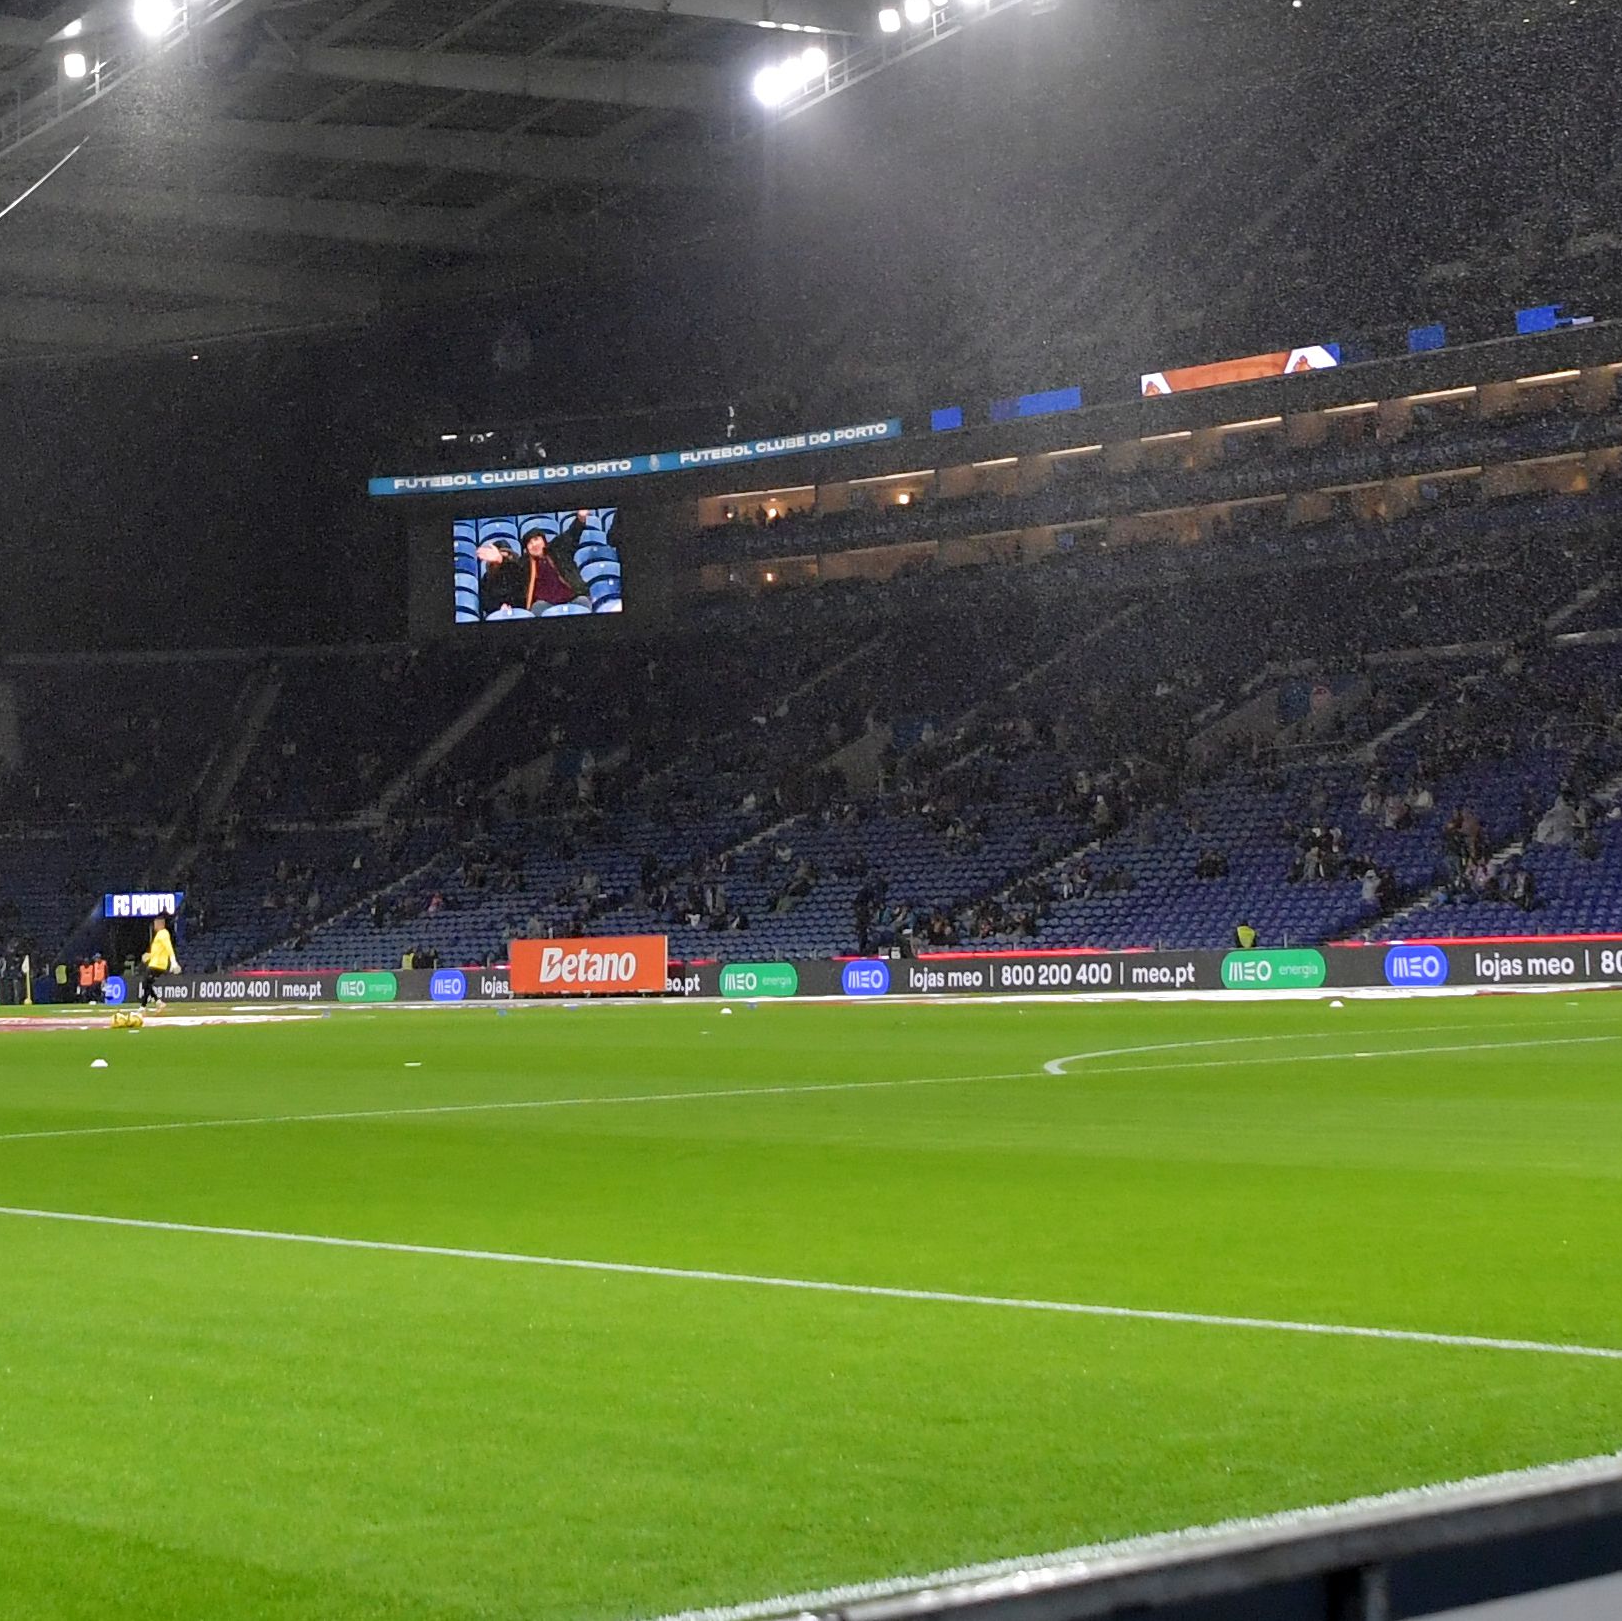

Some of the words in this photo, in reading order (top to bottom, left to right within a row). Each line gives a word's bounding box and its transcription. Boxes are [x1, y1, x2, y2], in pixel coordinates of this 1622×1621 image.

[679, 444, 752, 464] FUTEBOL
[755, 436, 806, 453] CLUBE
[809, 431, 831, 445] DO
[834, 423, 887, 441] PORTO
[394, 474, 477, 489] FUTEBOL
[481, 468, 540, 484] CLUBE
[543, 466, 569, 479] DO
[572, 460, 632, 476] PORTO
[113, 895, 130, 916] FC
[132, 894, 175, 915] PORTO
[539, 947, 637, 983] Betano
[1229, 960, 1271, 981] MEO
[1279, 962, 1318, 978] energia
[1393, 955, 1440, 978] MEO
[1475, 952, 1522, 981] lojas
[1527, 956, 1575, 976] meo
[434, 979, 461, 995] MEO
[481, 977, 509, 998] lojas
[665, 974, 700, 995] eo.pt
[725, 973, 757, 990] MEO
[848, 970, 883, 989] MEO
[910, 968, 945, 991] lojas
[948, 970, 983, 987] meo
[1001, 964, 1034, 985] 800
[1038, 964, 1072, 984] 200
[1076, 963, 1112, 984] 400
[1132, 963, 1195, 987] meo.pt
[165, 986, 188, 998] meo
[200, 982, 222, 998] 800
[224, 981, 246, 997] 200
[247, 981, 270, 996] 400
[282, 981, 322, 1000] meo.pt
[341, 980, 365, 996] MEO
